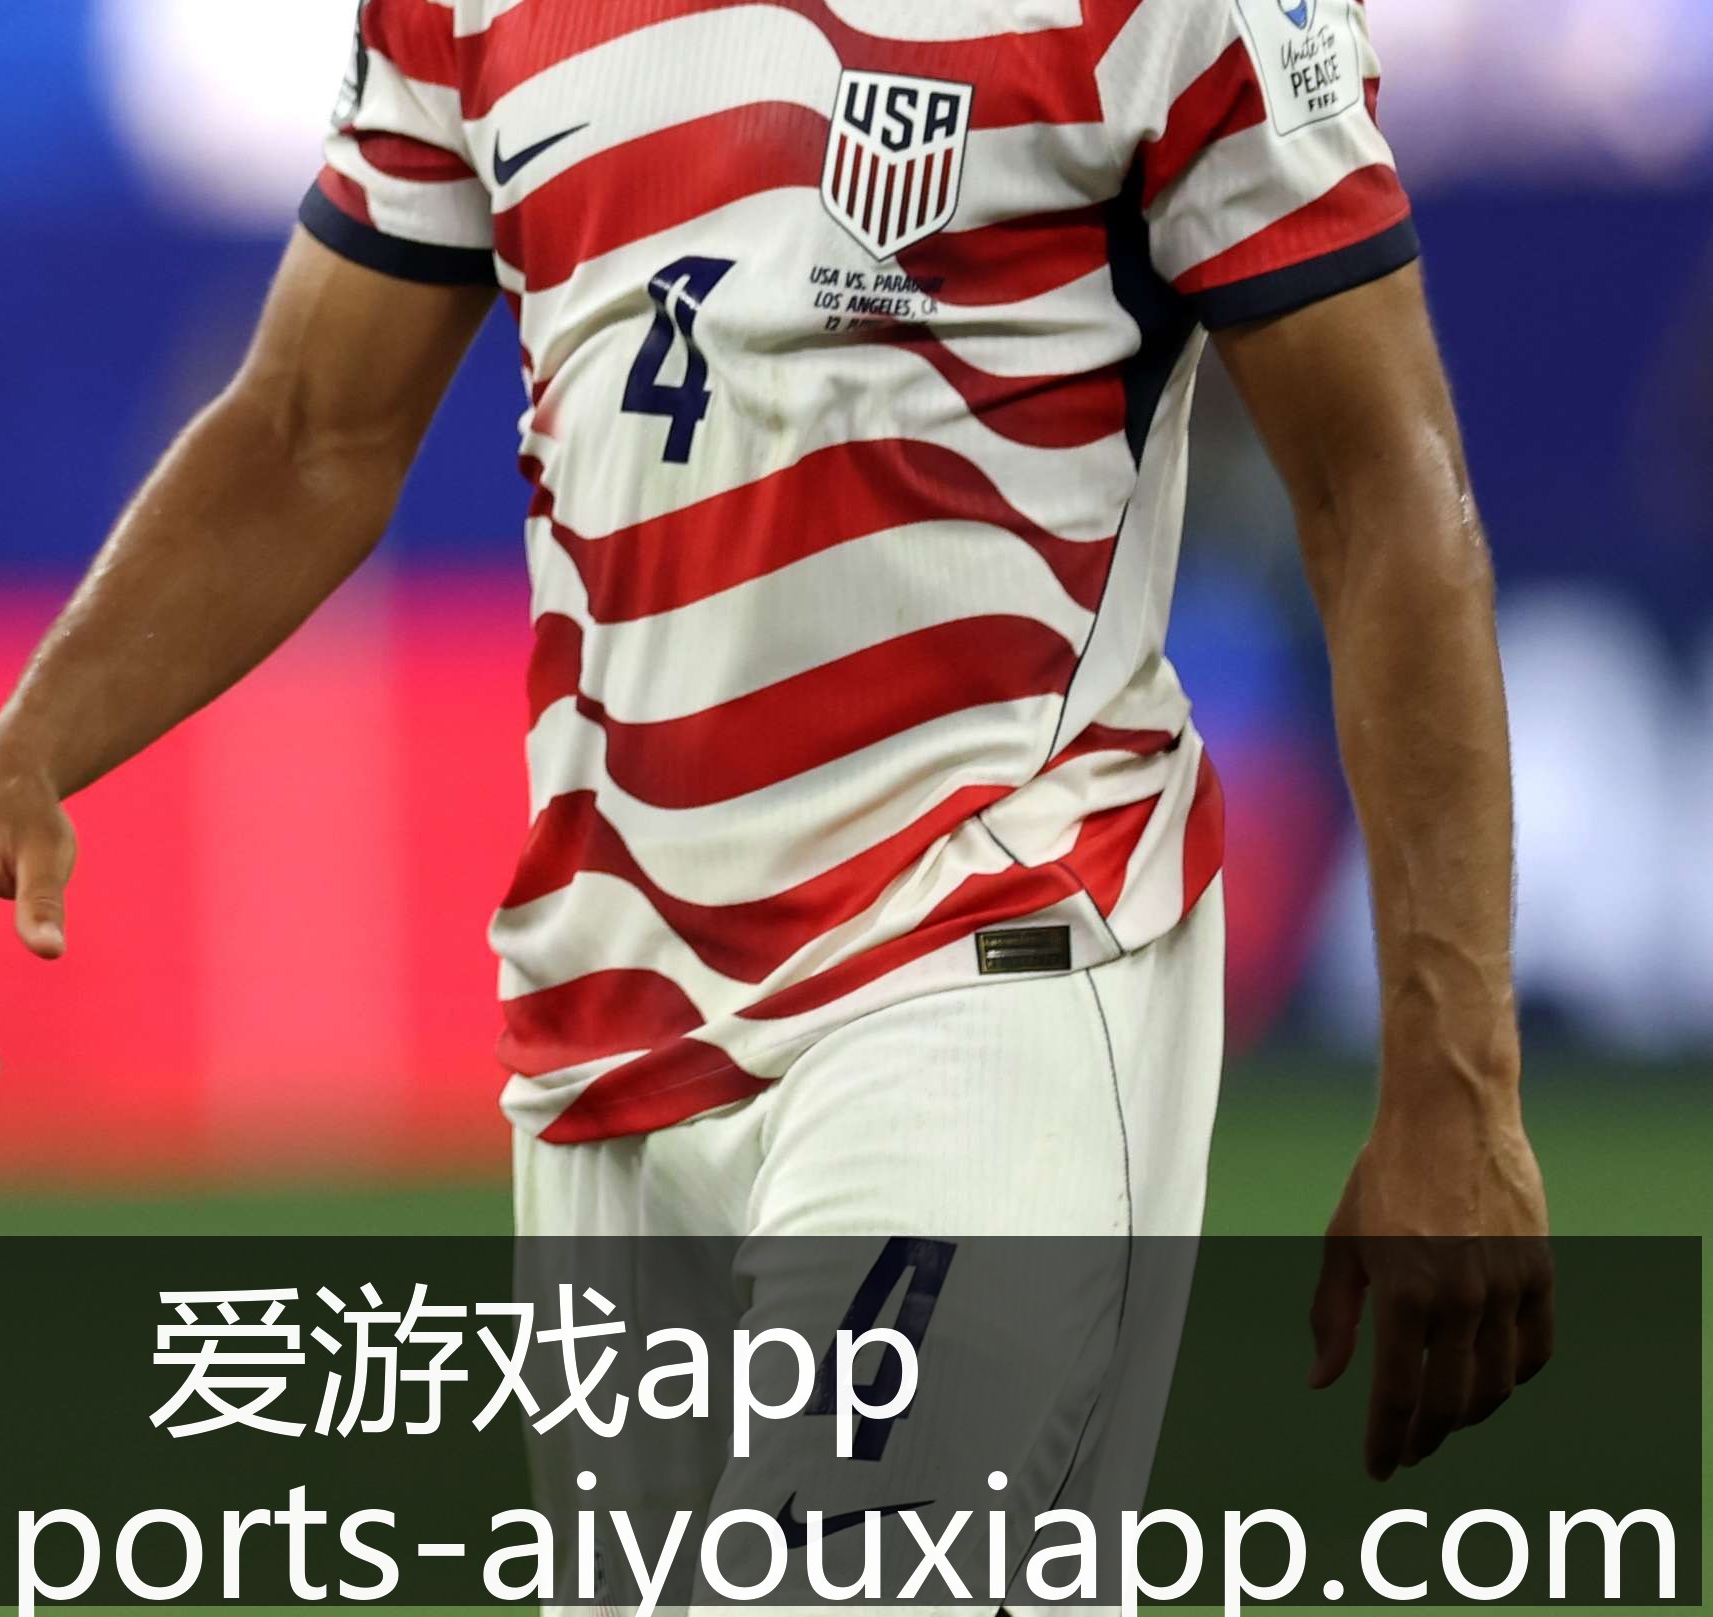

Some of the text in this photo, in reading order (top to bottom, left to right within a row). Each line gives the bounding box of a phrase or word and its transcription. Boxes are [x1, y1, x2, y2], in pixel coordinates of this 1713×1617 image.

[1289, 54, 1341, 99] PEACE
[843, 81, 961, 153] USA
[810, 266, 841, 285] USA
[846, 270, 866, 291] VS.
[814, 290, 843, 310] LOS
[846, 295, 916, 318] ANGELES,
[825, 315, 841, 331] 12
[621, 255, 737, 465] 4
